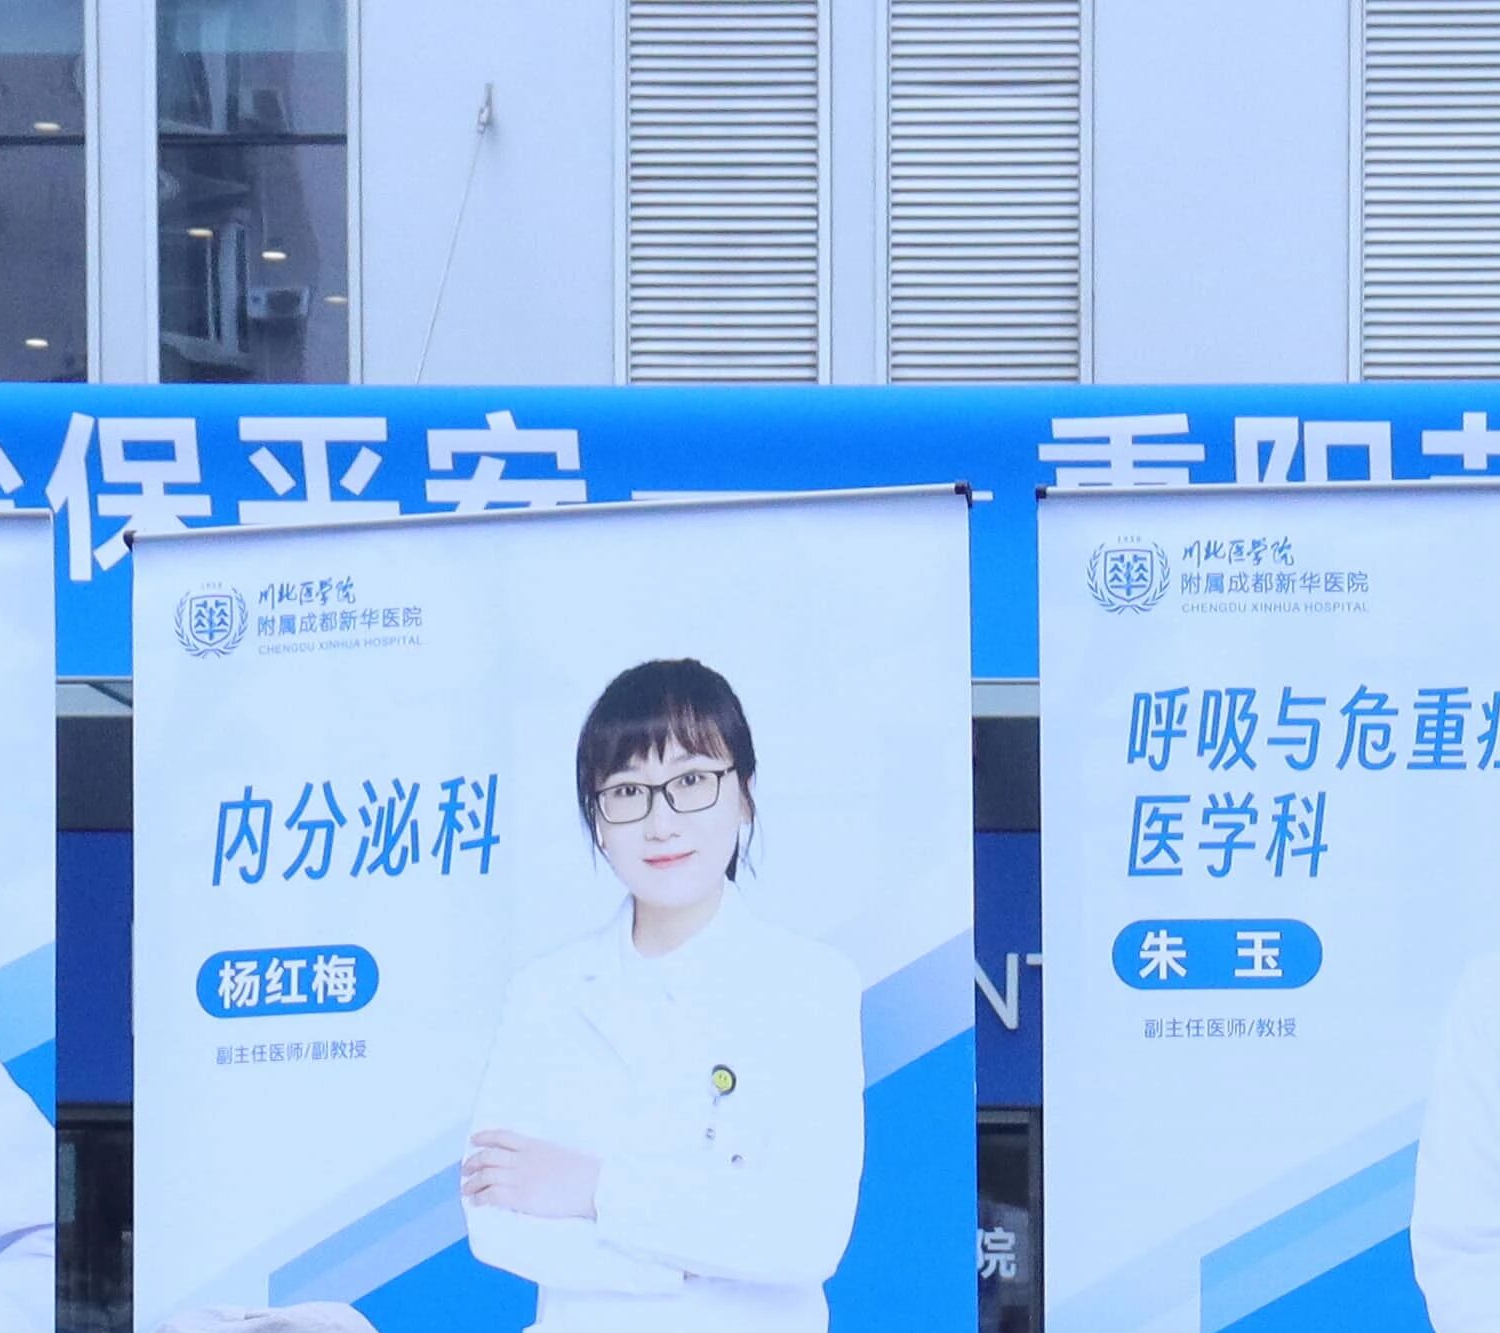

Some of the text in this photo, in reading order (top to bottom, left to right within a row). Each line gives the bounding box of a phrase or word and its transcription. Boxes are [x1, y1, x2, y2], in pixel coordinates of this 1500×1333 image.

[1181, 571, 1369, 595] 附属成都新华医院
[257, 605, 422, 637] 附属成都新华医院
[1182, 602, 1369, 613] CHENGDU XINHUA HOSPITAL
[210, 774, 502, 888] 内分泌科
[1125, 792, 1329, 879] 医学科
[217, 956, 358, 1010] 杨红梅
[1143, 1015, 1297, 1041] 副主任医师/教授
[215, 1037, 367, 1066] 副主任医师/副教授
